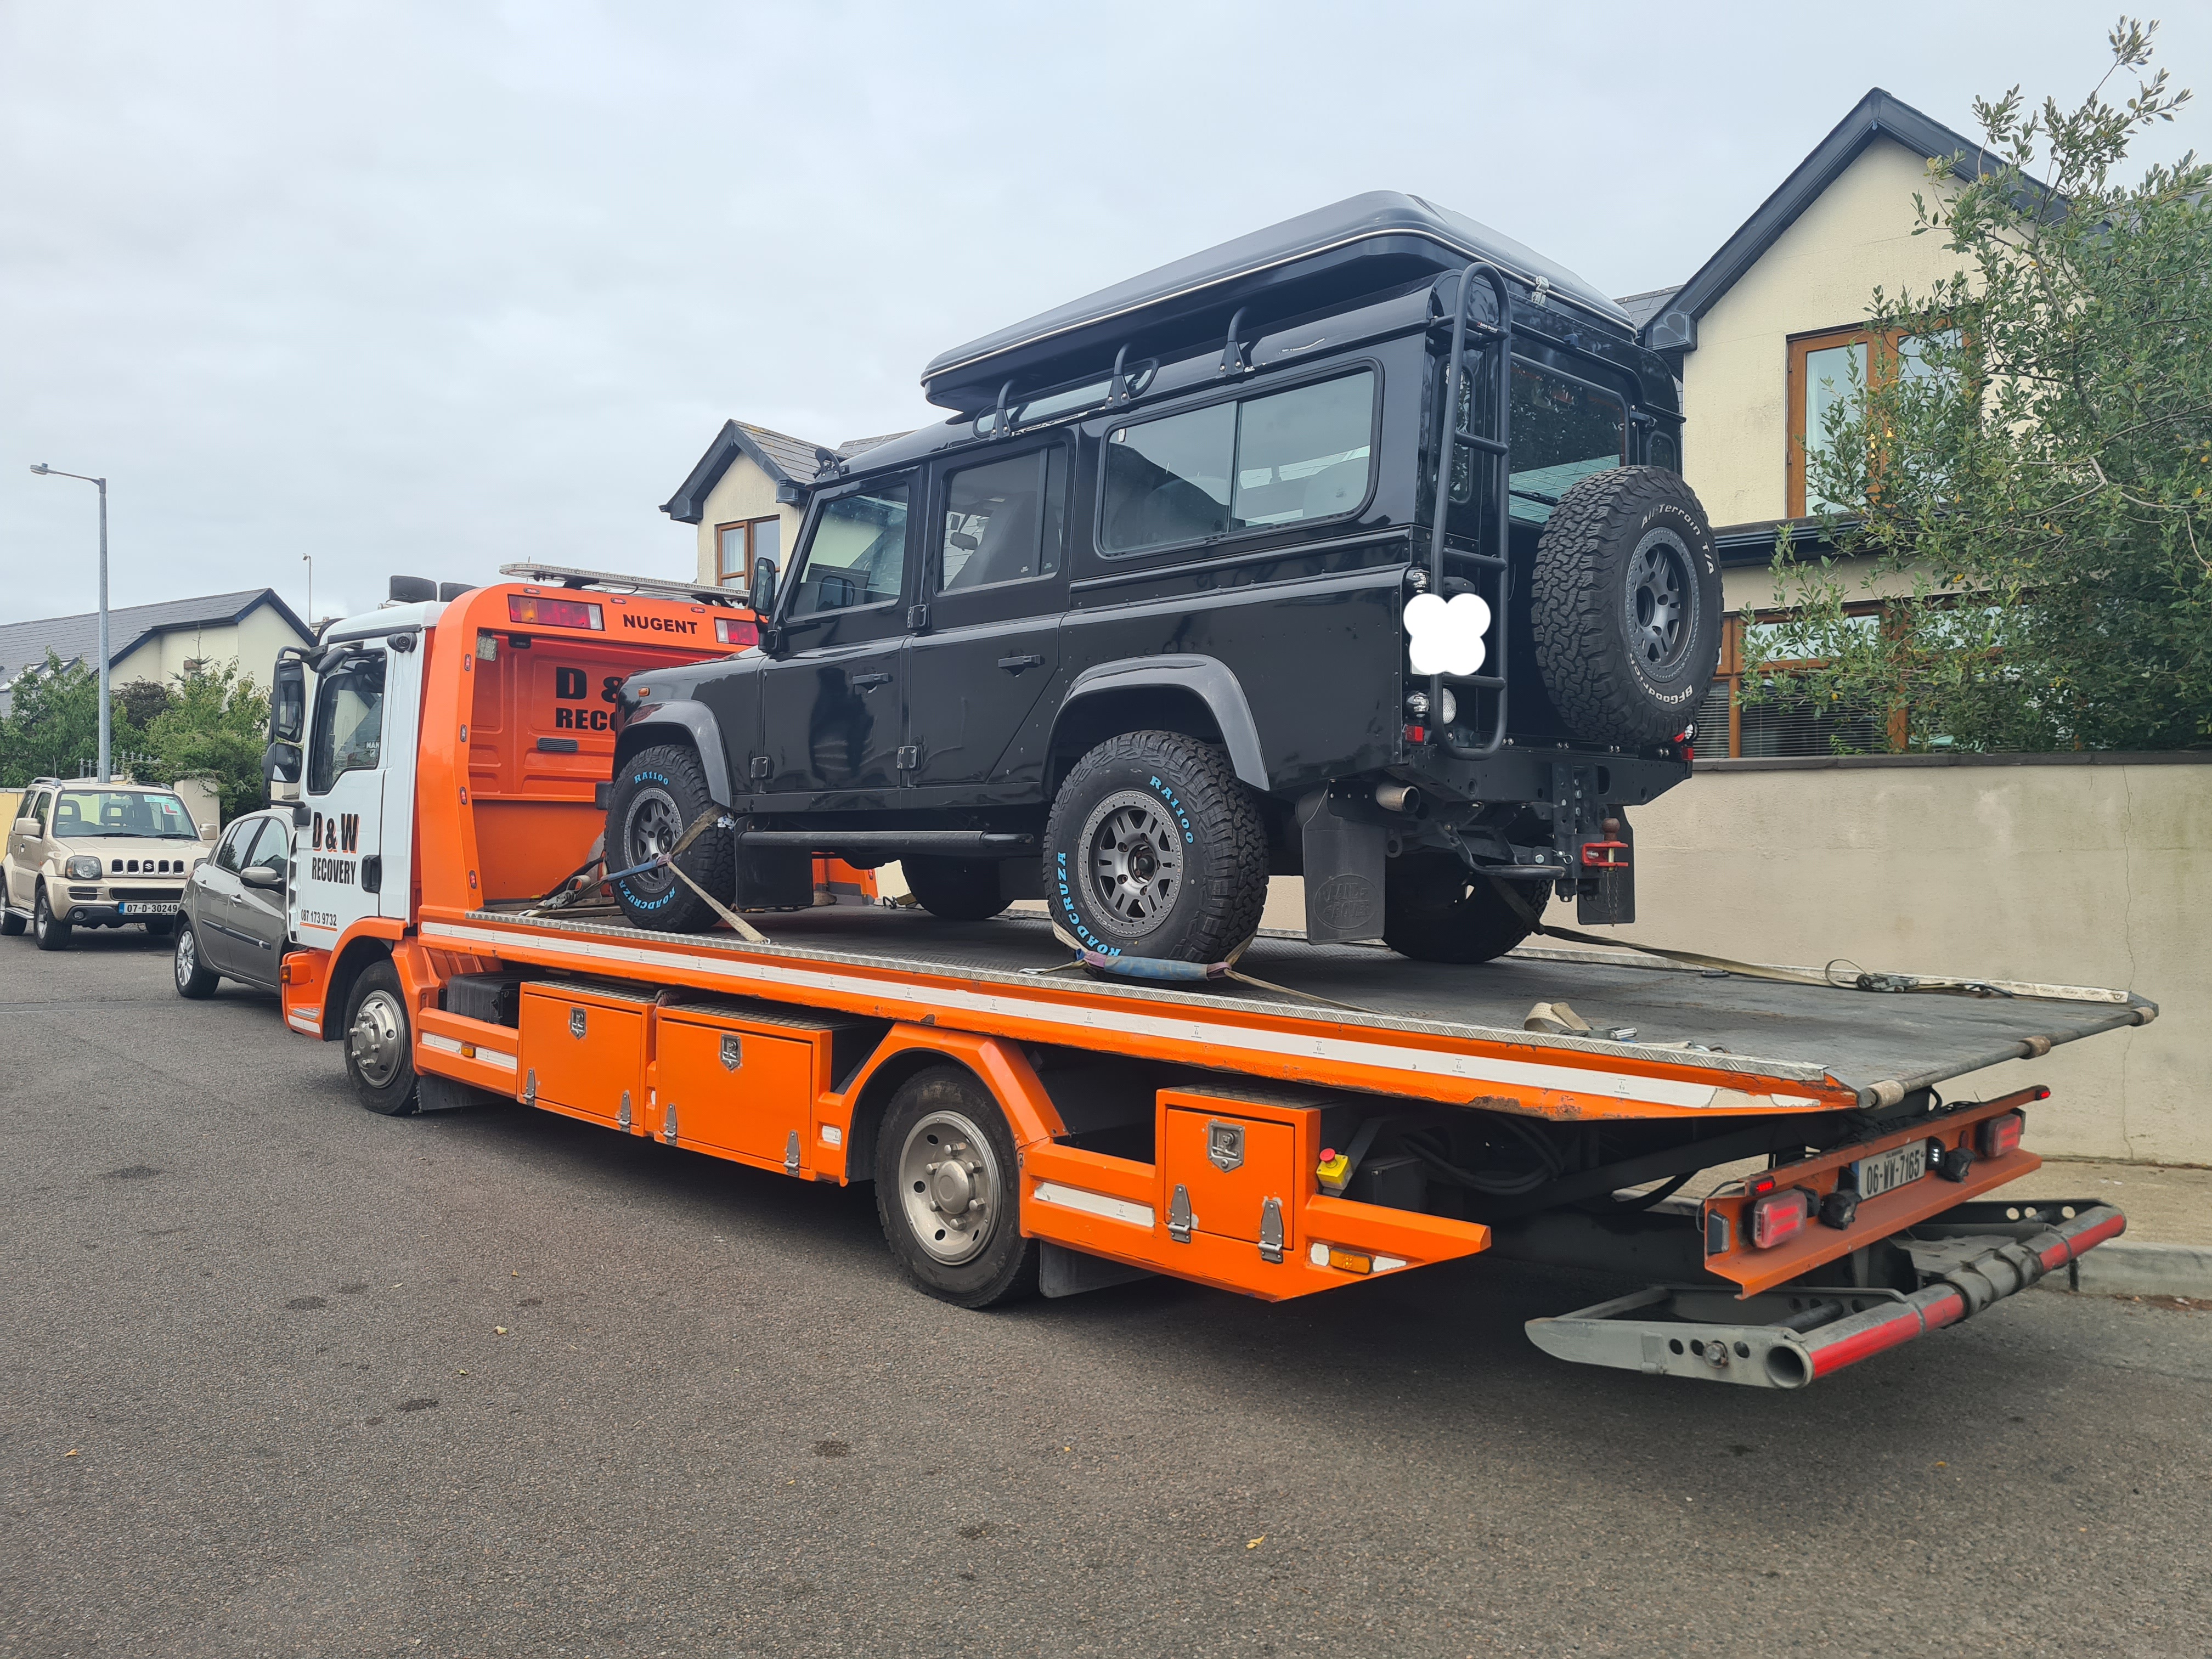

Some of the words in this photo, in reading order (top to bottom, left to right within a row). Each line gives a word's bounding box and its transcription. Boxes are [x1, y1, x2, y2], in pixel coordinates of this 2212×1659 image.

[1702, 541, 1715, 574] T/A
[623, 614, 698, 634] NUGENT
[556, 667, 587, 699] D
[601, 676, 623, 703] &
[1629, 653, 1693, 705] BFGoodrich
[634, 770, 669, 785] RA1100
[164, 805, 178, 814] L
[1149, 775, 1194, 844] RA1100
[312, 811, 323, 850] D
[325, 817, 337, 852] &
[341, 813, 359, 853] W
[312, 856, 357, 885] RECOVERY
[127, 904, 177, 912] 07-D-30249
[618, 879, 675, 910] ROADCRUZA
[1058, 851, 1121, 957] ROADCRUZA
[301, 909, 309, 922] 087
[311, 910, 320, 924] 173
[322, 913, 337, 927] 9732
[1866, 1149, 1920, 1195] 06-WW-7165
